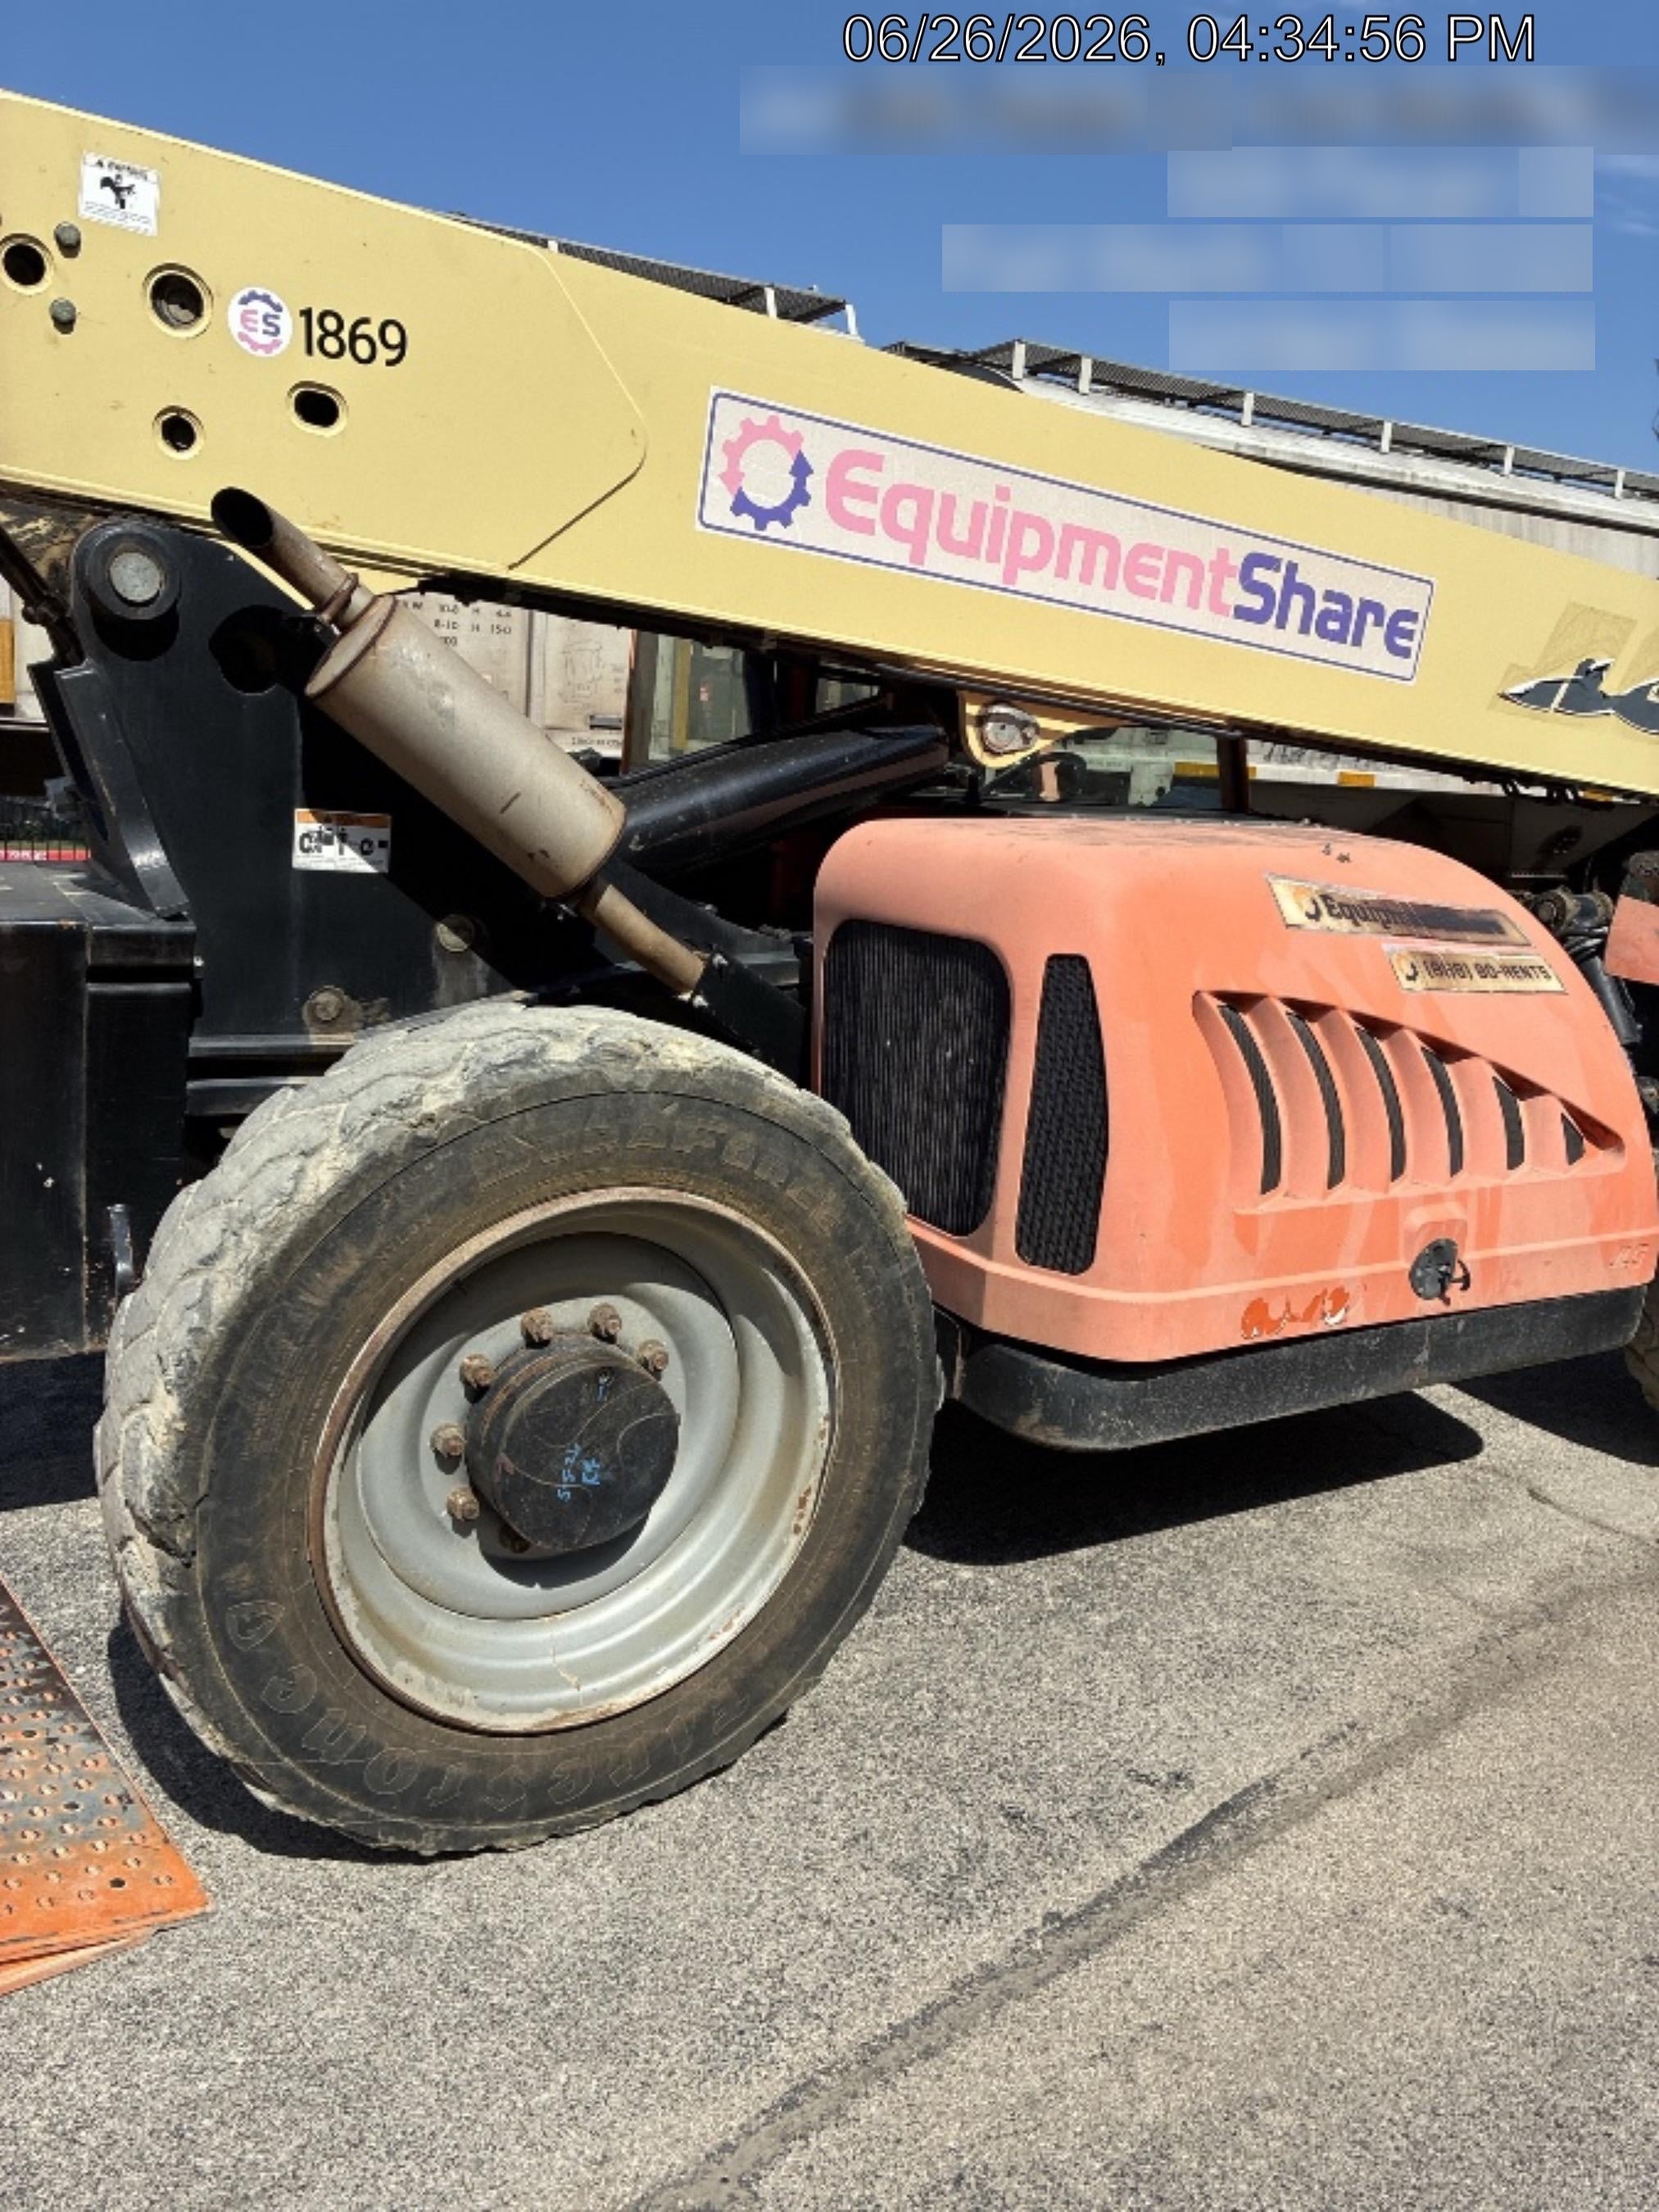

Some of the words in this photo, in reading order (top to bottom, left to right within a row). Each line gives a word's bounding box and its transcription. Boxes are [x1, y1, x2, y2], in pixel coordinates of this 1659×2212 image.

[240, 309, 280, 337] ES
[300, 307, 407, 366] 1869
[825, 449, 1420, 660] EquipmentShare
